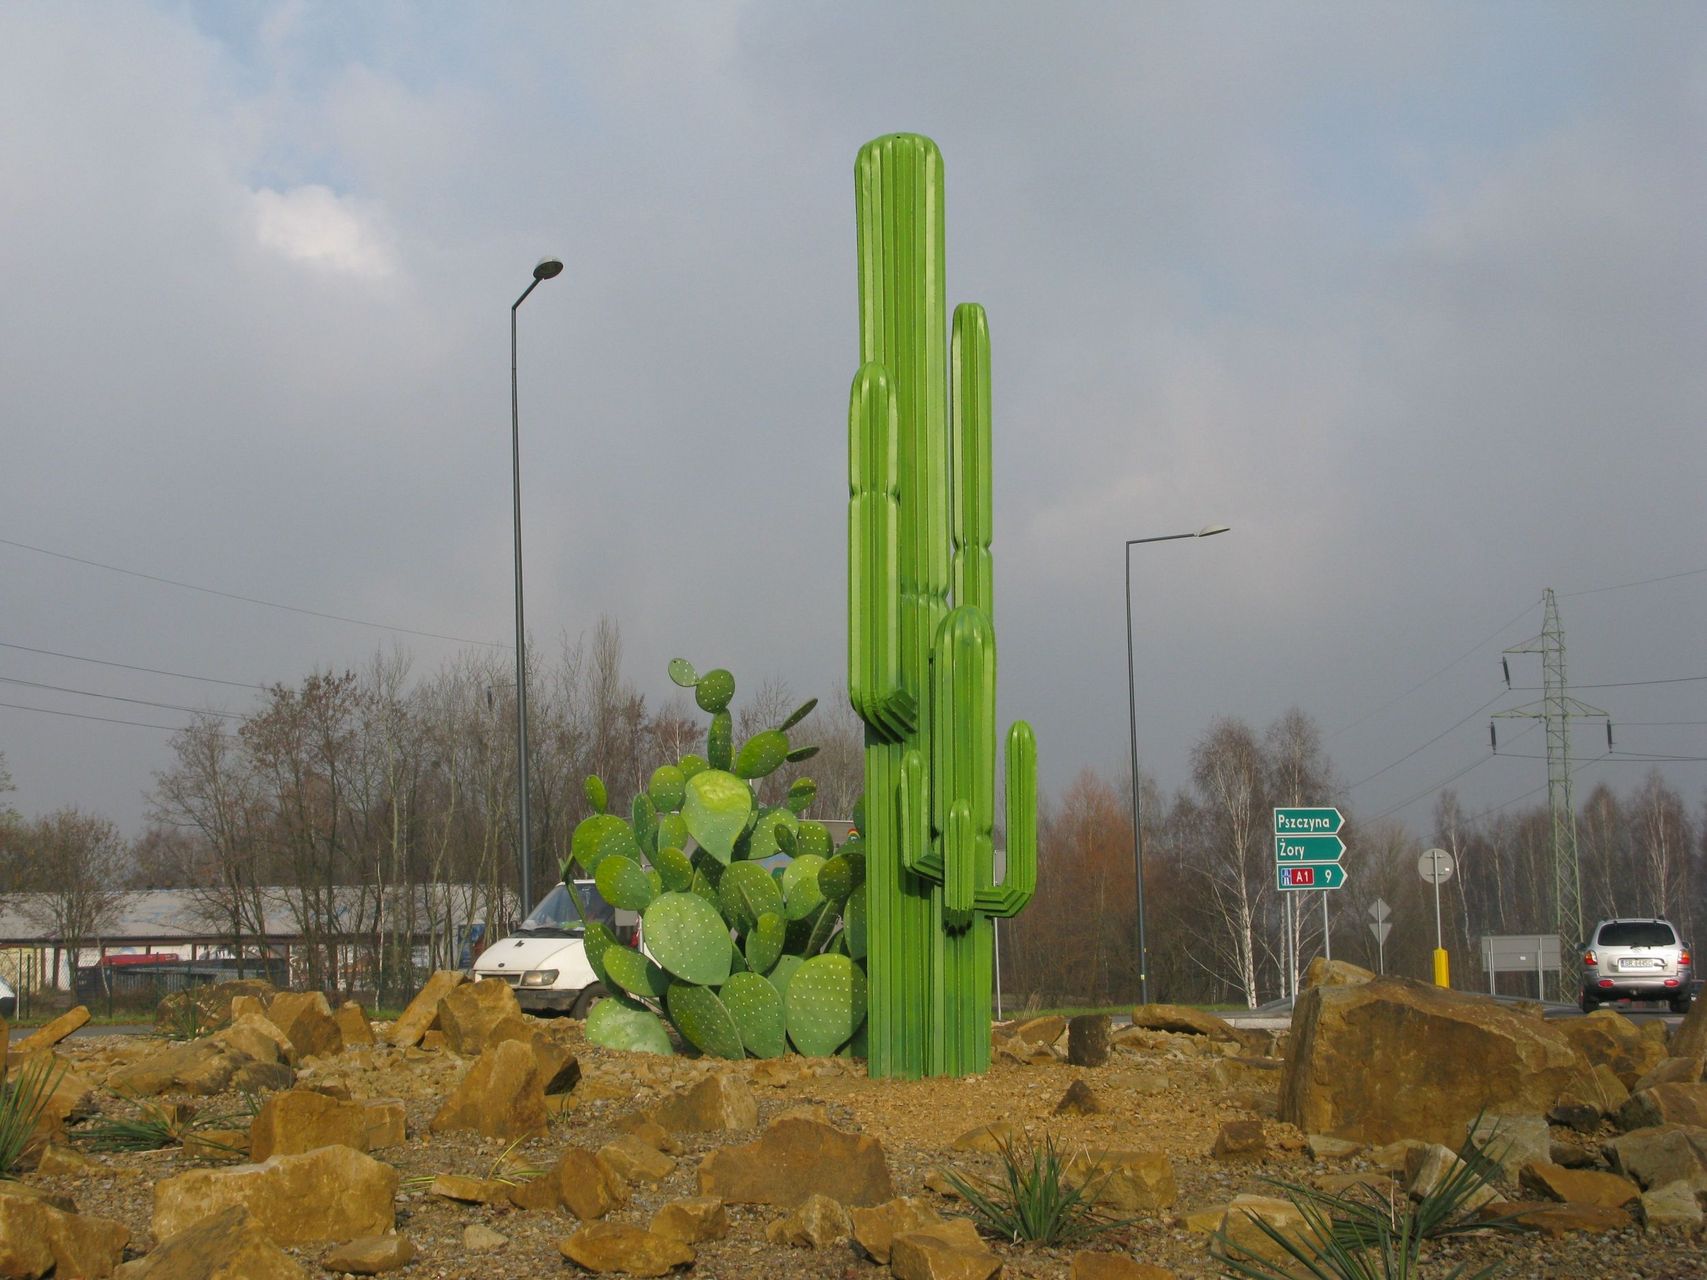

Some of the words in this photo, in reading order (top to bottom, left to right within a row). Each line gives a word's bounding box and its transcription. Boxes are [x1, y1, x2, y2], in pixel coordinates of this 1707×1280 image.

[1278, 814, 1330, 831] Pszczyna
[1280, 839, 1304, 859] Żory
[1296, 871, 1309, 882] A1
[1325, 869, 1332, 883] 9
